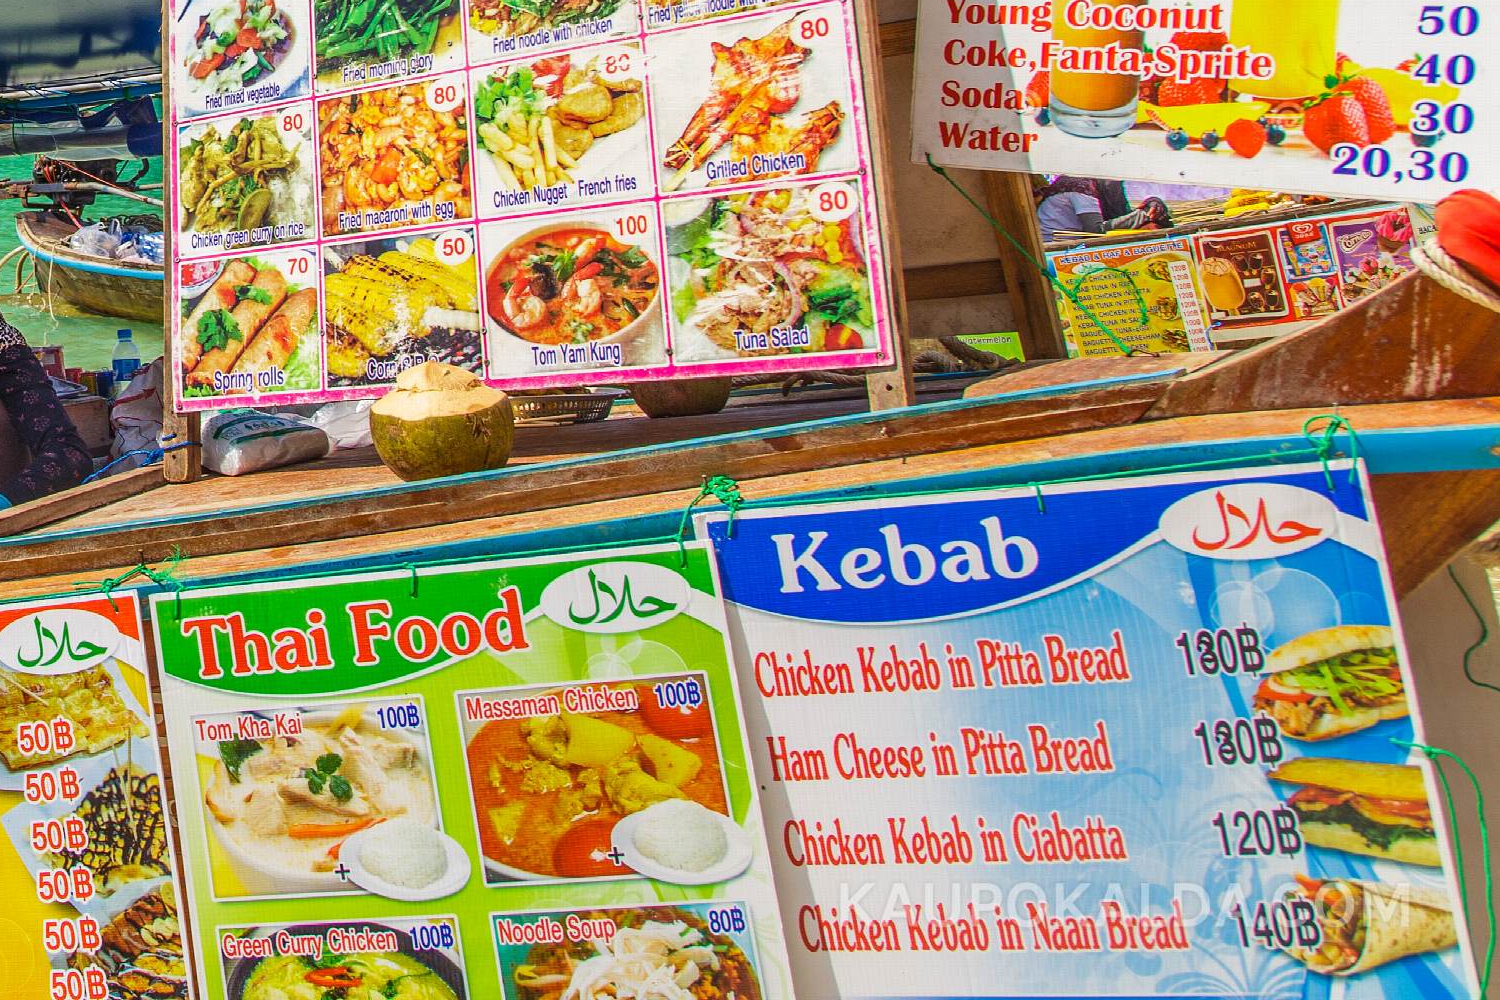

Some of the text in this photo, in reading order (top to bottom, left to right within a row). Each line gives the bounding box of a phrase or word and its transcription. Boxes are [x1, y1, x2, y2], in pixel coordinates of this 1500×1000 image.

[1066, 0, 1224, 30] Coconut
[342, 53, 434, 82] Fried morning glory
[943, 39, 1272, 80] Coke,Fanta,Sprite
[1413, 54, 1476, 85] 40
[205, 83, 281, 110] Fried mixed vegetable
[940, 80, 1023, 110] Soda
[1413, 102, 1475, 134] 30
[938, 121, 1039, 153] Water
[706, 153, 805, 180] Grilled Chicken
[1332, 145, 1469, 183] 20,30
[493, 175, 637, 208] Chicken Nugget French fries
[819, 190, 848, 212] 80
[339, 201, 454, 230] Fried macaroni with egg
[615, 215, 647, 235] 100
[190, 222, 304, 250] Chicken green curry on rice
[287, 256, 308, 276] 70
[531, 342, 621, 365] Tom Yam Kung
[733, 326, 809, 350] Tuna Salad
[214, 366, 284, 392] Spring rolls
[1192, 490, 1323, 551] حلال
[771, 515, 1039, 594] Kebab
[569, 567, 678, 625] حلال
[17, 615, 109, 668] حلال
[182, 585, 532, 679] Thai Food
[753, 629, 1130, 698] Chicken Kebab in Pitta Bread
[465, 687, 639, 721] Massaman Chicken
[194, 714, 303, 742] Tom Kha Kai
[767, 721, 1114, 781] Ham Cheese in Pitta Bread
[783, 811, 1128, 867] Chicken Kebab in Ciabatta
[498, 916, 617, 944] Noodle Soup
[799, 899, 1189, 953] Chicken Kebab in Naan Bread
[222, 928, 398, 959] Green Curry Chicken
